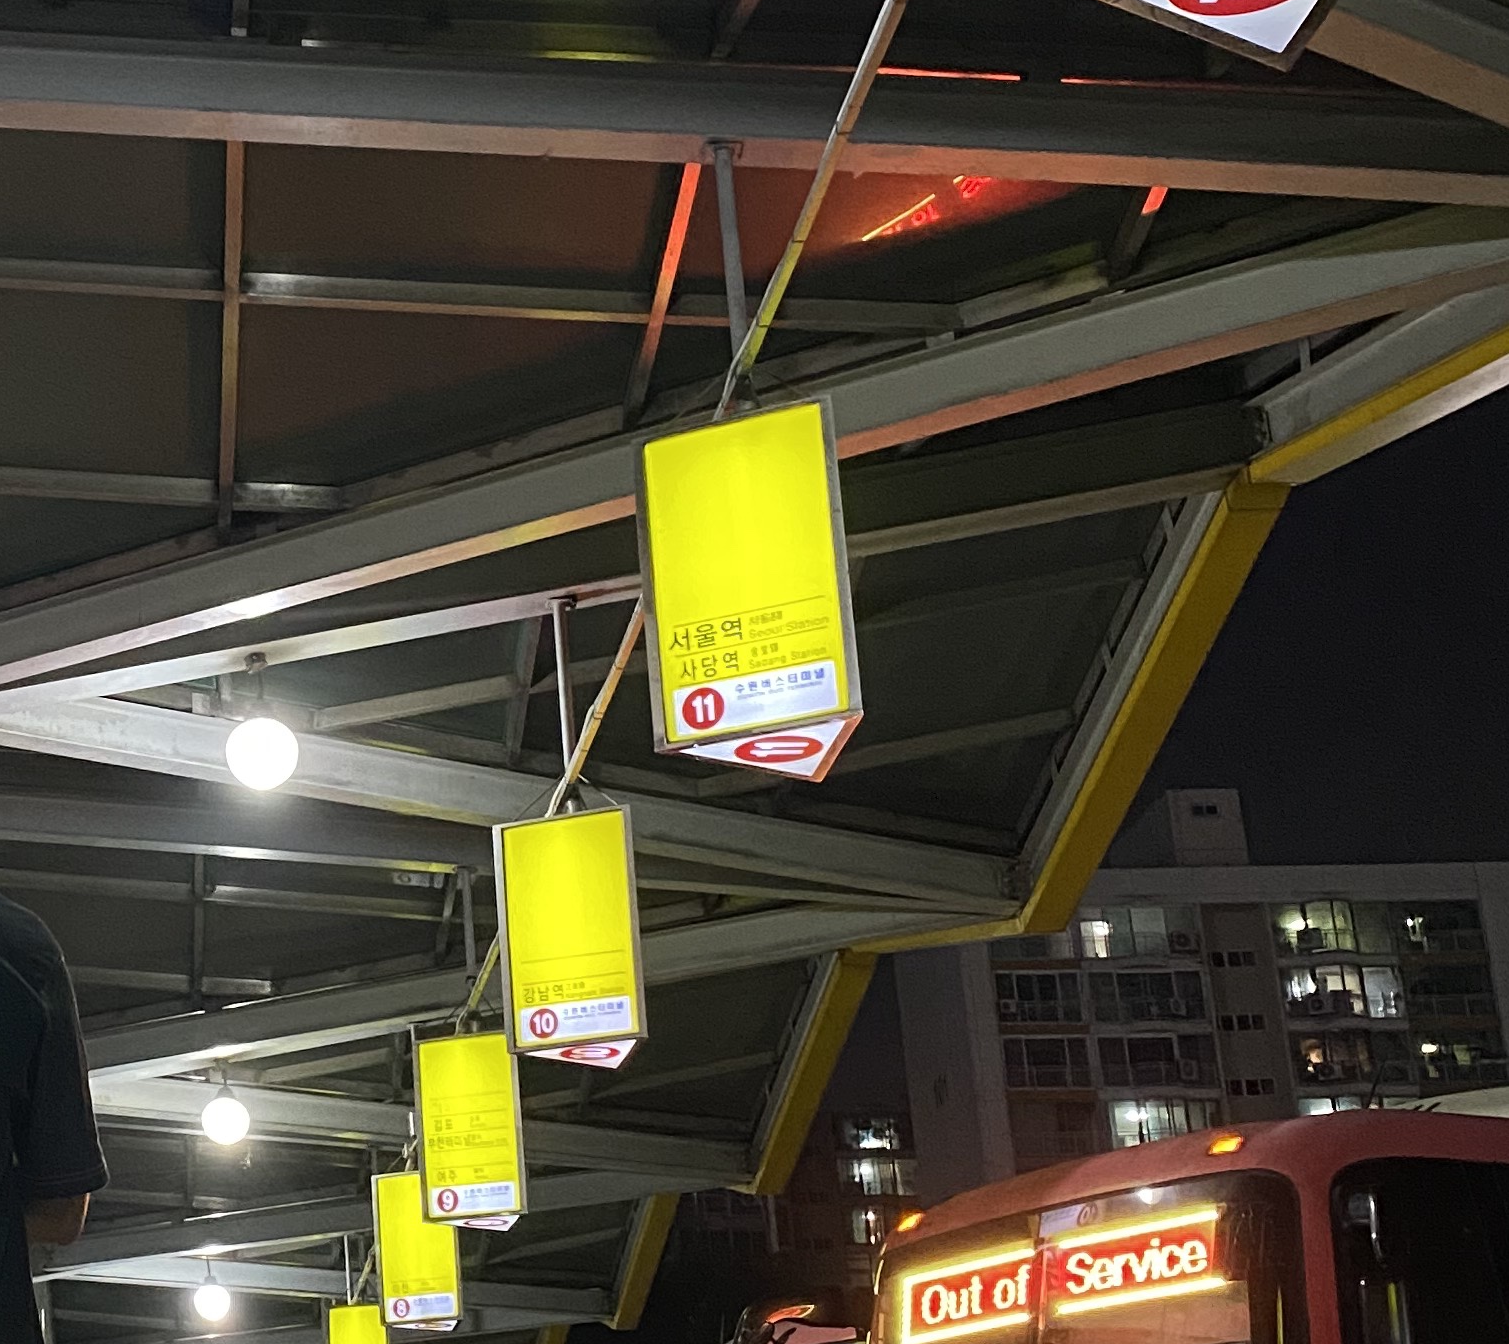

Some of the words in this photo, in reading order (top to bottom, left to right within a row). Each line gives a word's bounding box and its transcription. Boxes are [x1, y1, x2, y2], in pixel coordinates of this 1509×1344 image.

[669, 616, 743, 652] 서울역
[680, 649, 740, 682] 사당역
[691, 693, 716, 723] 11
[522, 984, 564, 1004] 강남역
[531, 1011, 555, 1035] 10
[441, 1191, 454, 1210] 9
[921, 1275, 983, 1325] Out
[993, 1264, 1031, 1309] of
[1066, 1237, 1209, 1296] Service
